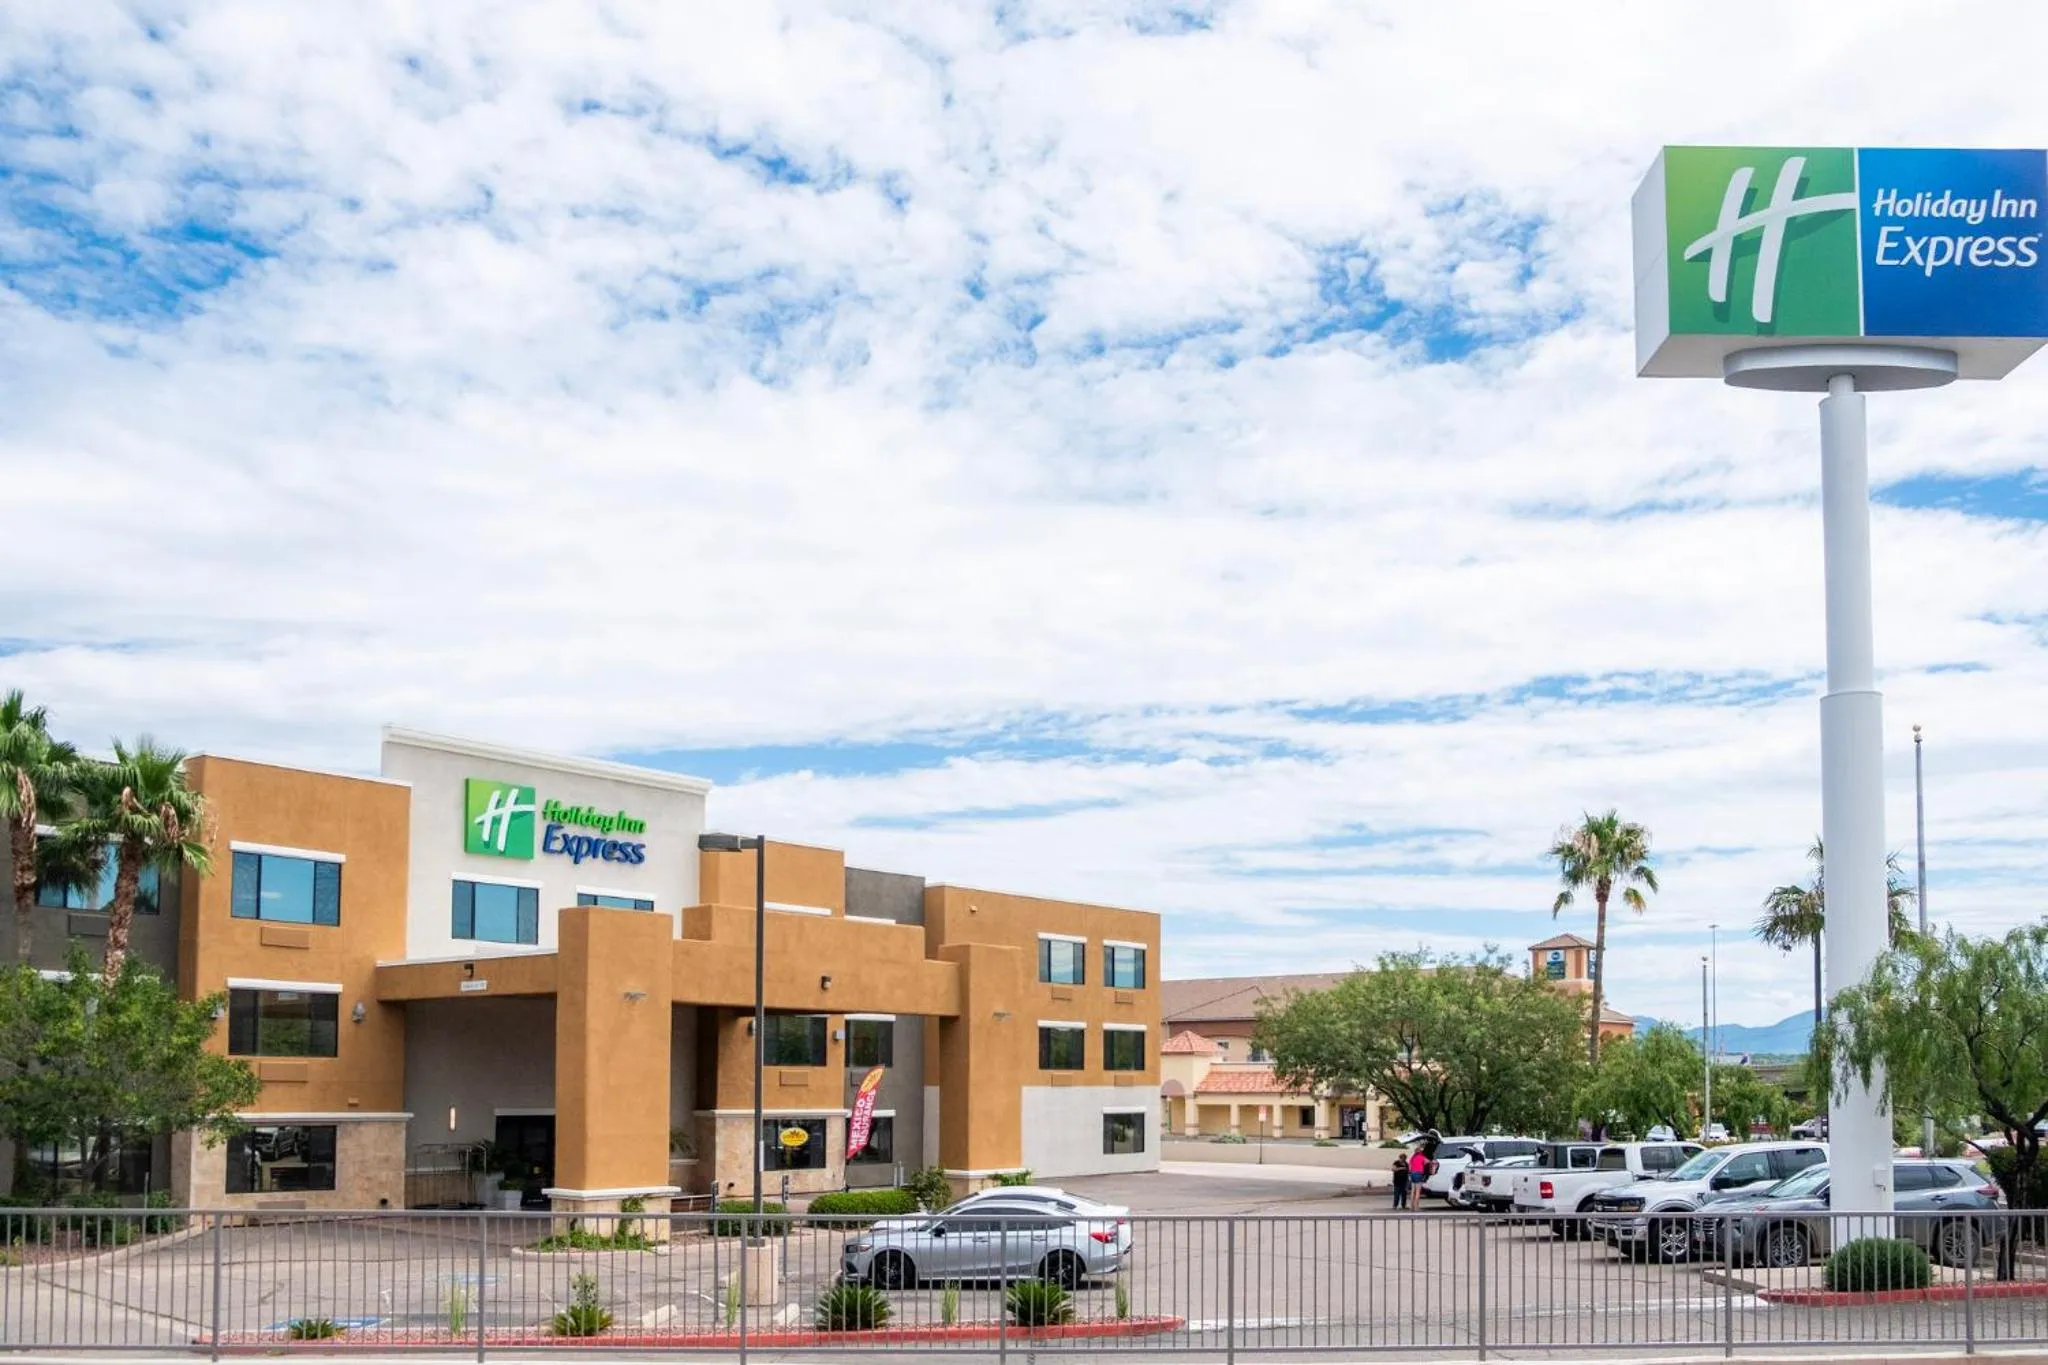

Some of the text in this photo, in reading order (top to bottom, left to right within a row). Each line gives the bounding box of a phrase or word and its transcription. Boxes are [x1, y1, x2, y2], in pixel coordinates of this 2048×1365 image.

[1872, 188, 2038, 225] Holiday Inn
[1875, 226, 2040, 278] Express
[542, 799, 647, 835] Holiday Inn
[542, 824, 647, 865] Express
[850, 1098, 865, 1150] MEXICO
[857, 1089, 876, 1146] INSURANCE
